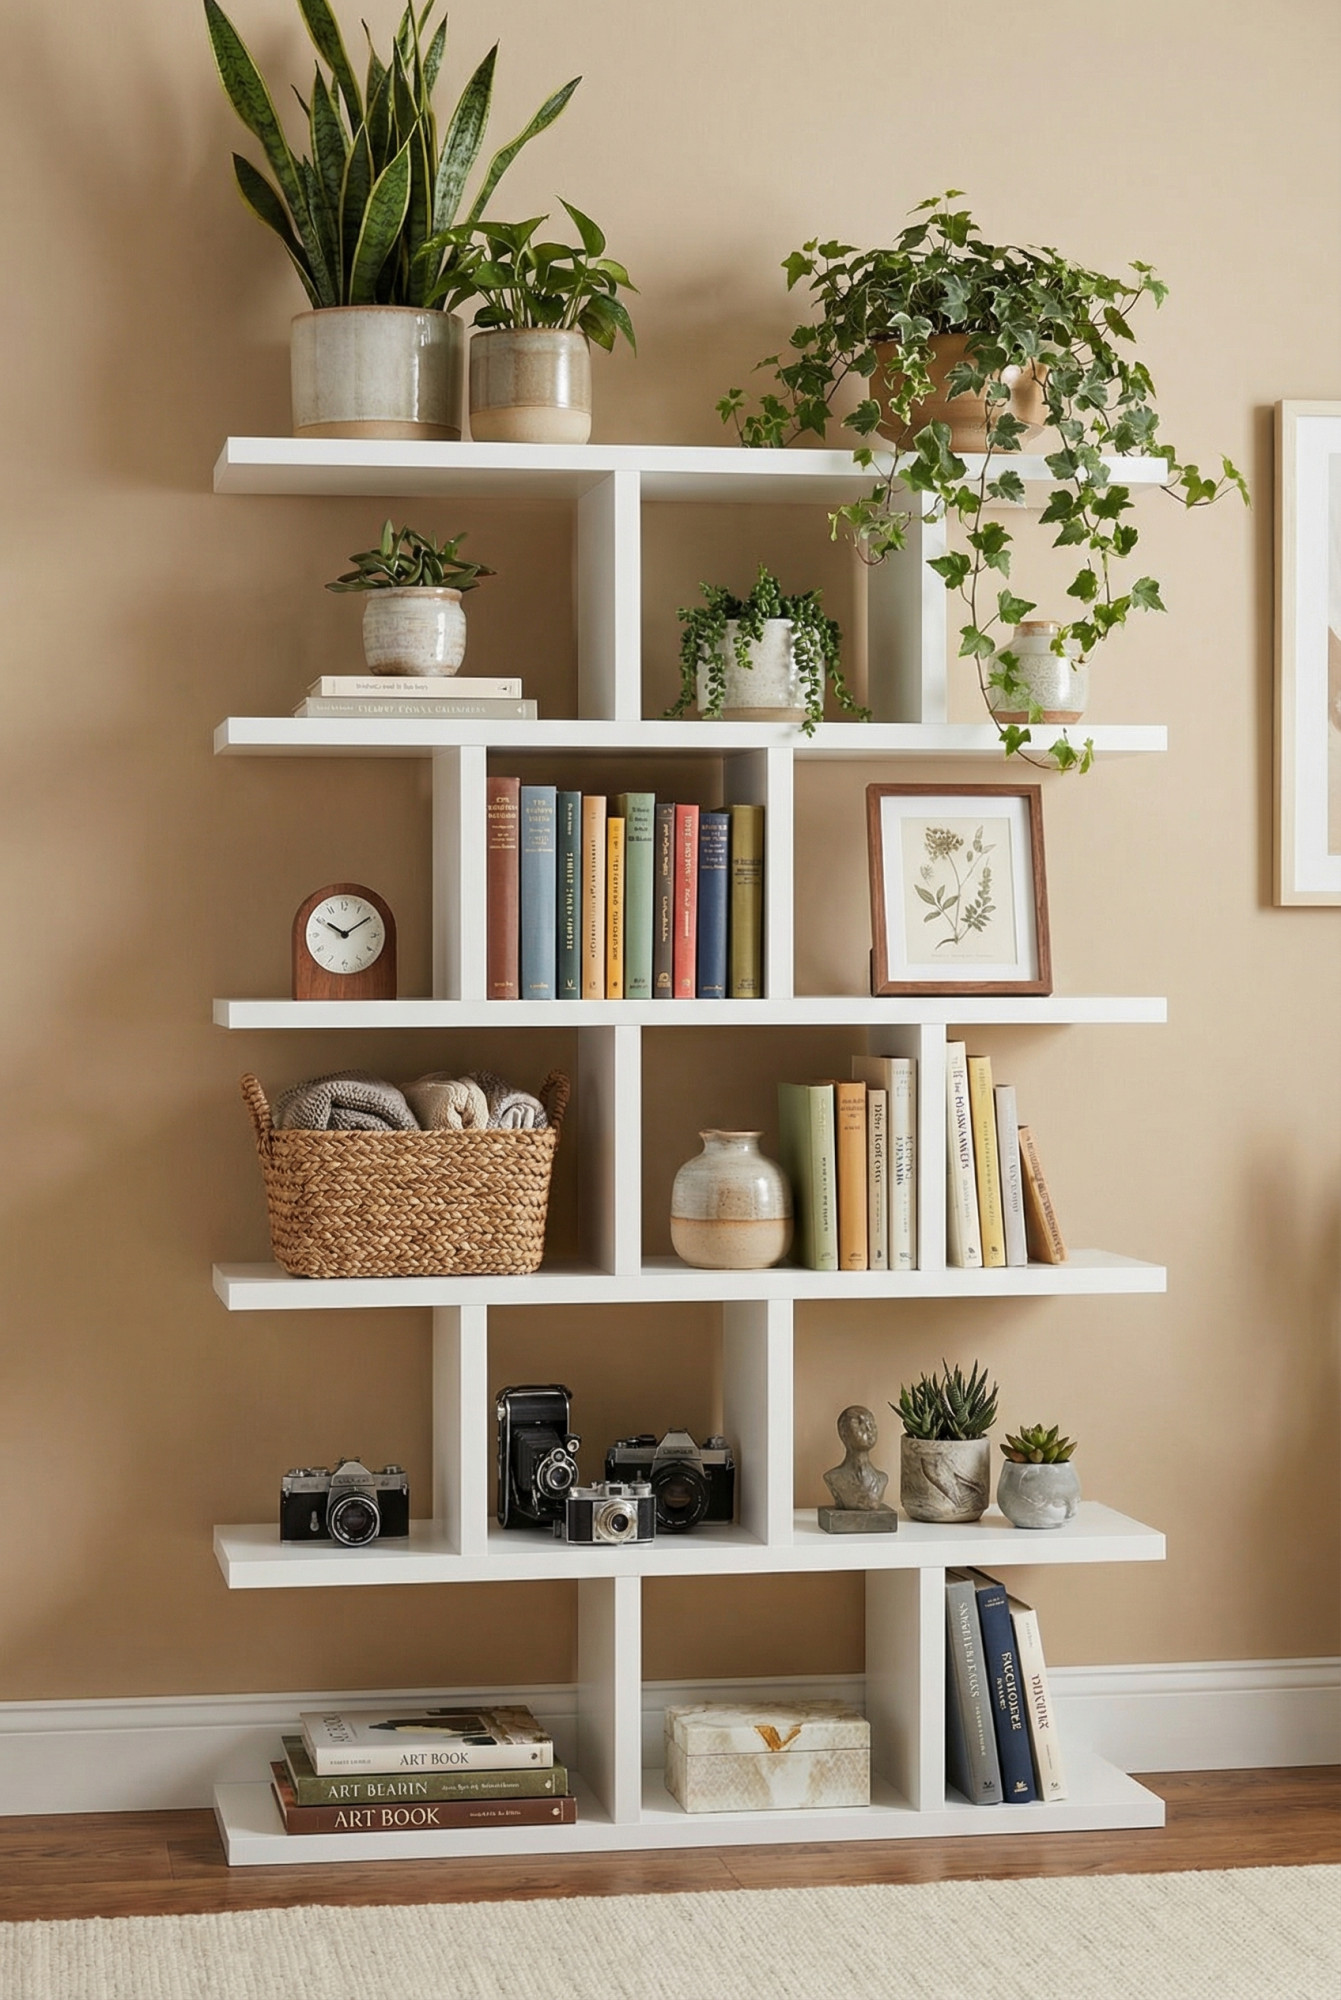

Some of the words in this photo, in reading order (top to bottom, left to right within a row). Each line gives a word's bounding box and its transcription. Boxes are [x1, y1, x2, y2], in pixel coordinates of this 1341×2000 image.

[400, 1753, 427, 1766] ART
[431, 1752, 469, 1765] BOOK
[328, 1784, 361, 1798] ART
[334, 1810, 376, 1828] ART
[381, 1807, 440, 1827] BOOK
